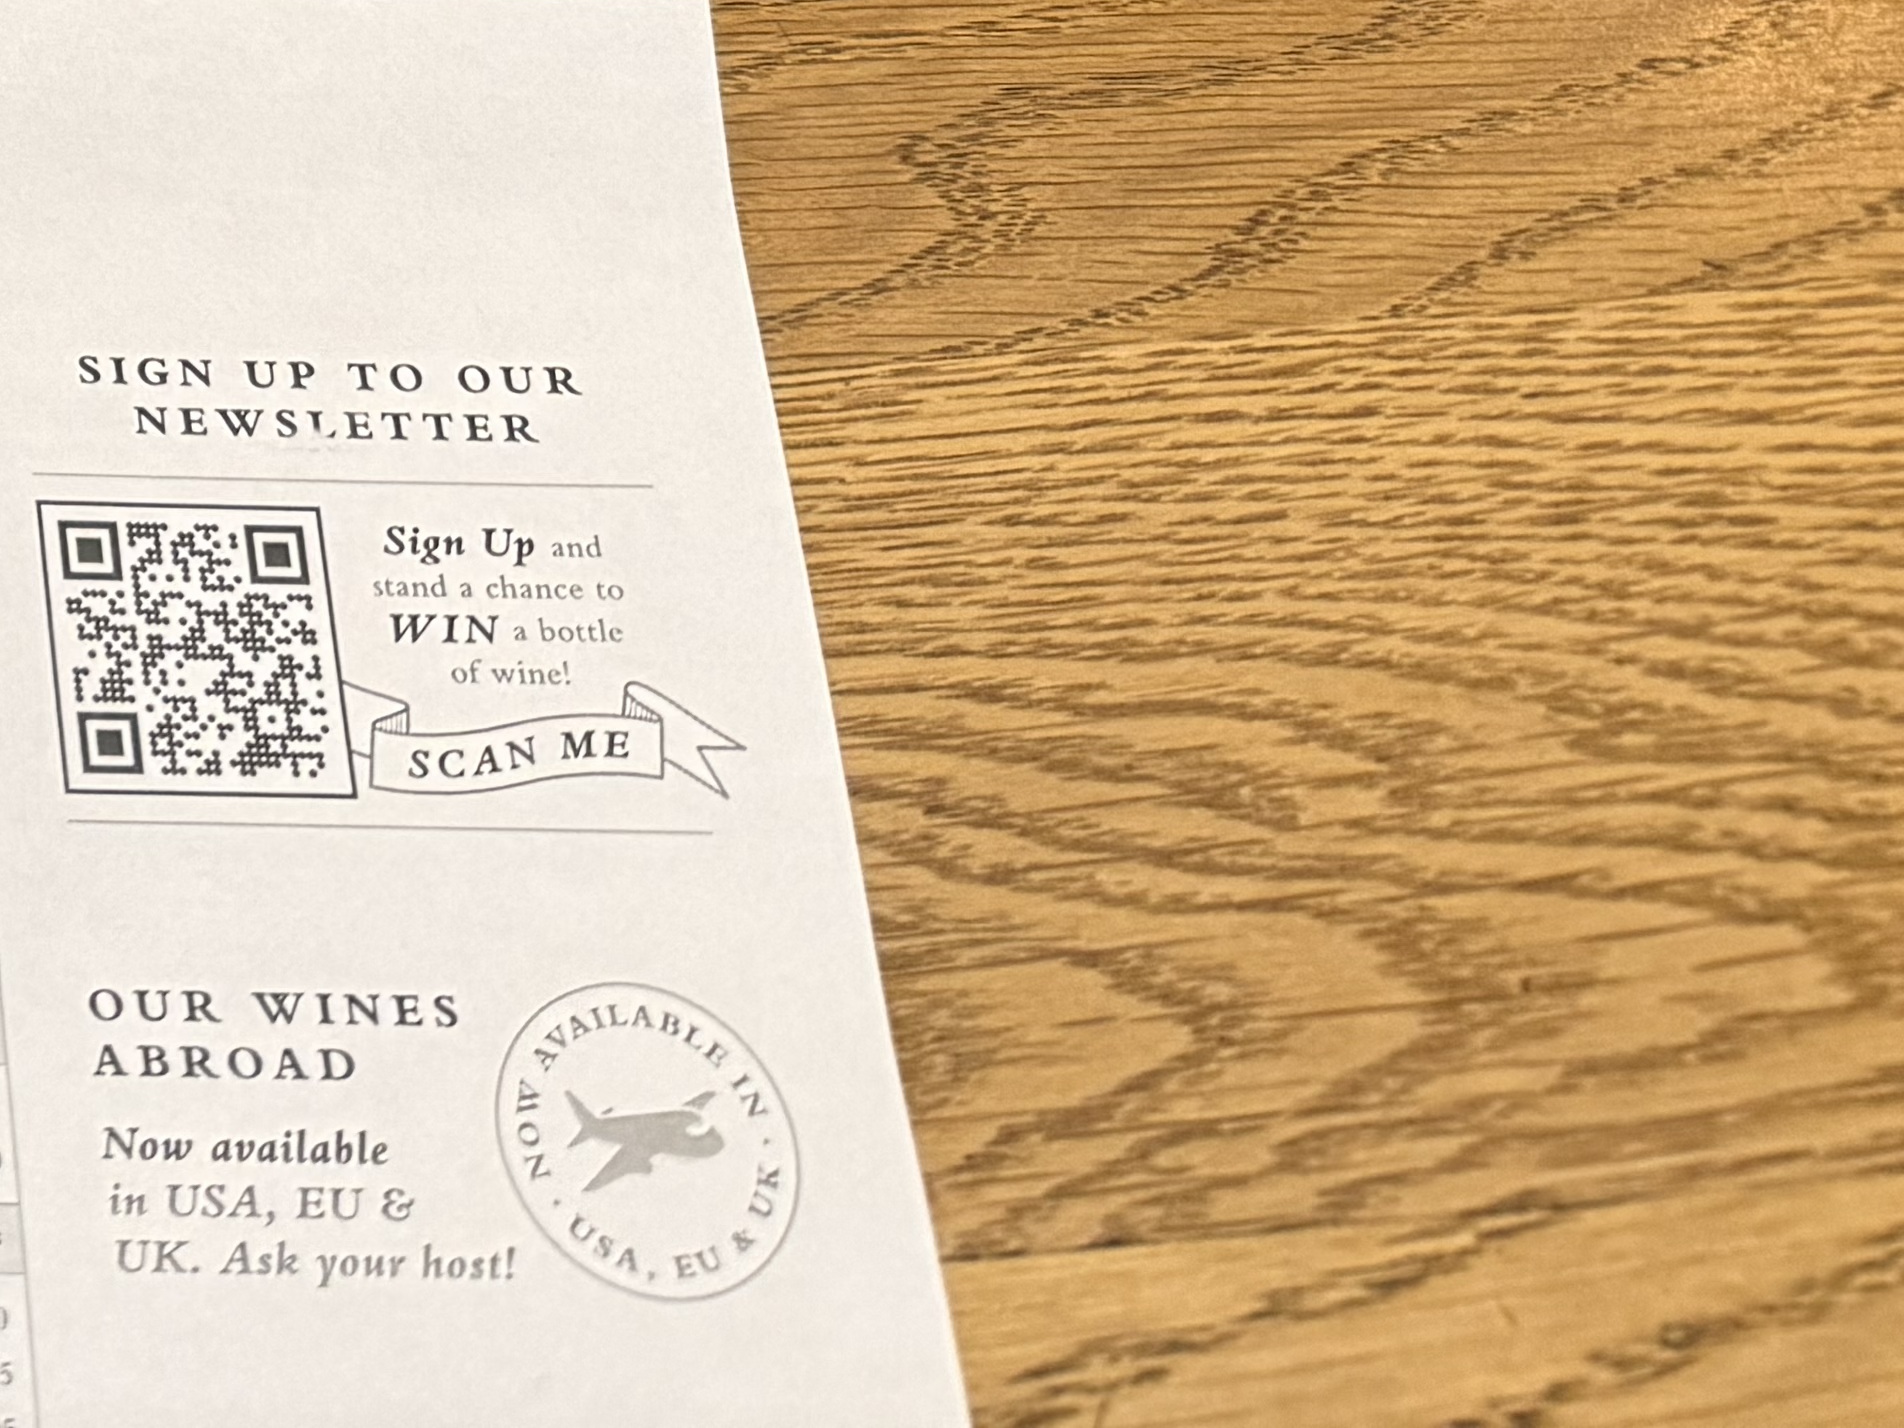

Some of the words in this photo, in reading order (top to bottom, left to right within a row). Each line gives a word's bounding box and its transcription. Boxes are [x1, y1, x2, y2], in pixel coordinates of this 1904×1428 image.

[78, 355, 212, 388] SIGN
[242, 360, 316, 390] UP
[346, 362, 423, 393] TO
[457, 364, 583, 396] OUR
[133, 405, 540, 444] NEWSLETTER
[383, 525, 466, 566] Sign
[481, 527, 535, 567] Up
[551, 534, 603, 559] and
[372, 572, 448, 598] stand
[459, 582, 473, 599] a
[485, 573, 584, 601] chance
[596, 582, 625, 601] to
[389, 613, 500, 645] WIN
[513, 625, 528, 642] a
[537, 616, 624, 644] bottle
[450, 658, 483, 685] of
[490, 659, 572, 686] wine!
[405, 731, 540, 784] SCAN
[556, 725, 636, 768] ME
[88, 988, 223, 1024] OUR
[251, 991, 458, 1029] WINES
[93, 1043, 356, 1081] ABROAD
[101, 1126, 194, 1162] Now
[211, 1128, 389, 1166] available
[108, 1182, 148, 1217] in
[165, 1183, 276, 1228] USA,
[295, 1186, 365, 1221] EU
[380, 1187, 415, 1223] &
[115, 1239, 201, 1274] UK.
[218, 1239, 300, 1276] Ask
[315, 1254, 407, 1289] your
[422, 1242, 517, 1281] host!
